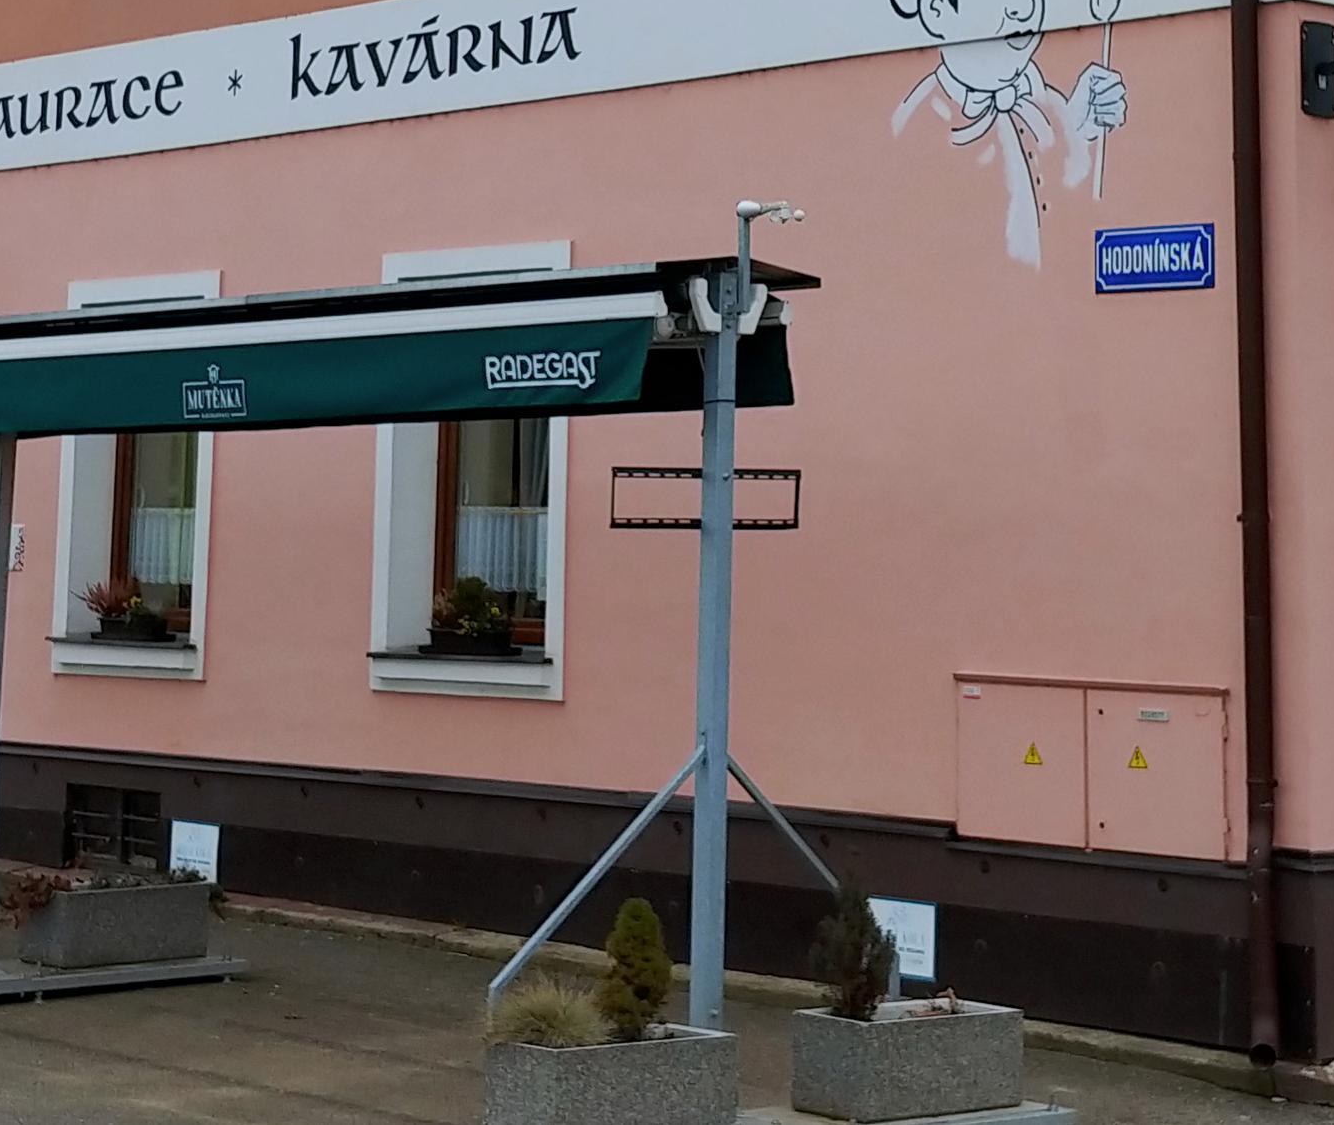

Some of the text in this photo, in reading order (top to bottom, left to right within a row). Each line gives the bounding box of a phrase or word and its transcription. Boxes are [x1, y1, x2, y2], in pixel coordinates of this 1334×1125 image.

[289, 6, 583, 100] KAVÁRNA
[1102, 236, 1204, 275] HODONÍNSKÁ
[486, 351, 601, 389] RADEGAST
